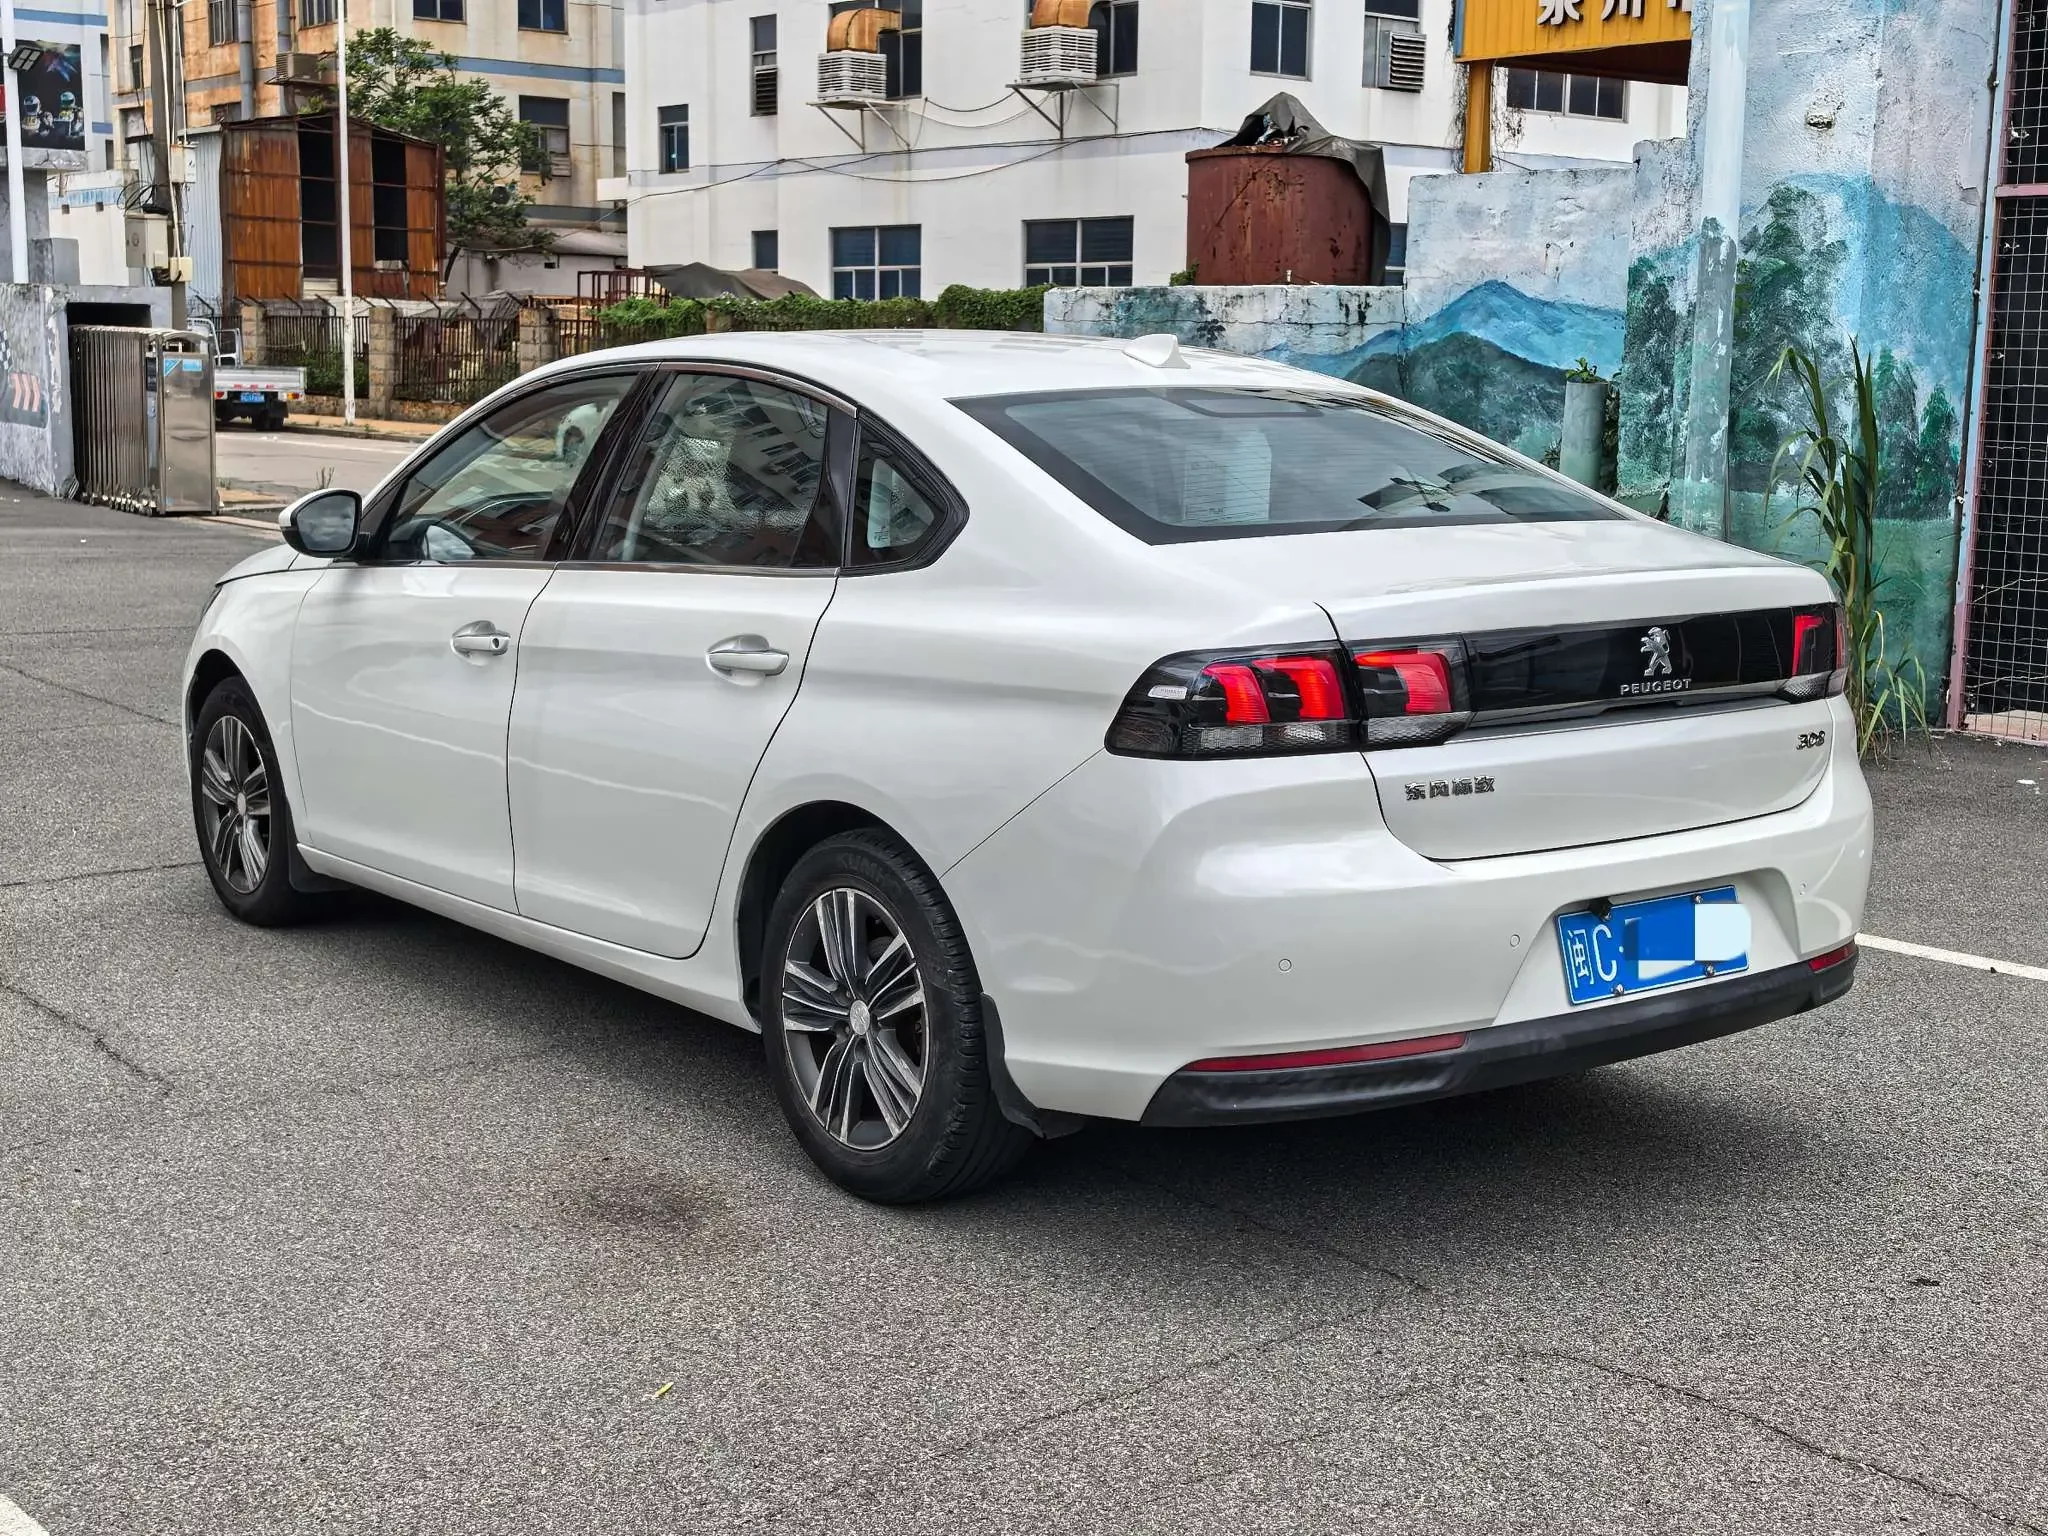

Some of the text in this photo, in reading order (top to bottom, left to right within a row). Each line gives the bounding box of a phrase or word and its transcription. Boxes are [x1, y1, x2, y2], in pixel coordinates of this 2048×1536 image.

[1620, 678, 1692, 696] PEUGEOT
[1796, 730, 1826, 750] 308
[1404, 774, 1496, 801] 东风标致
